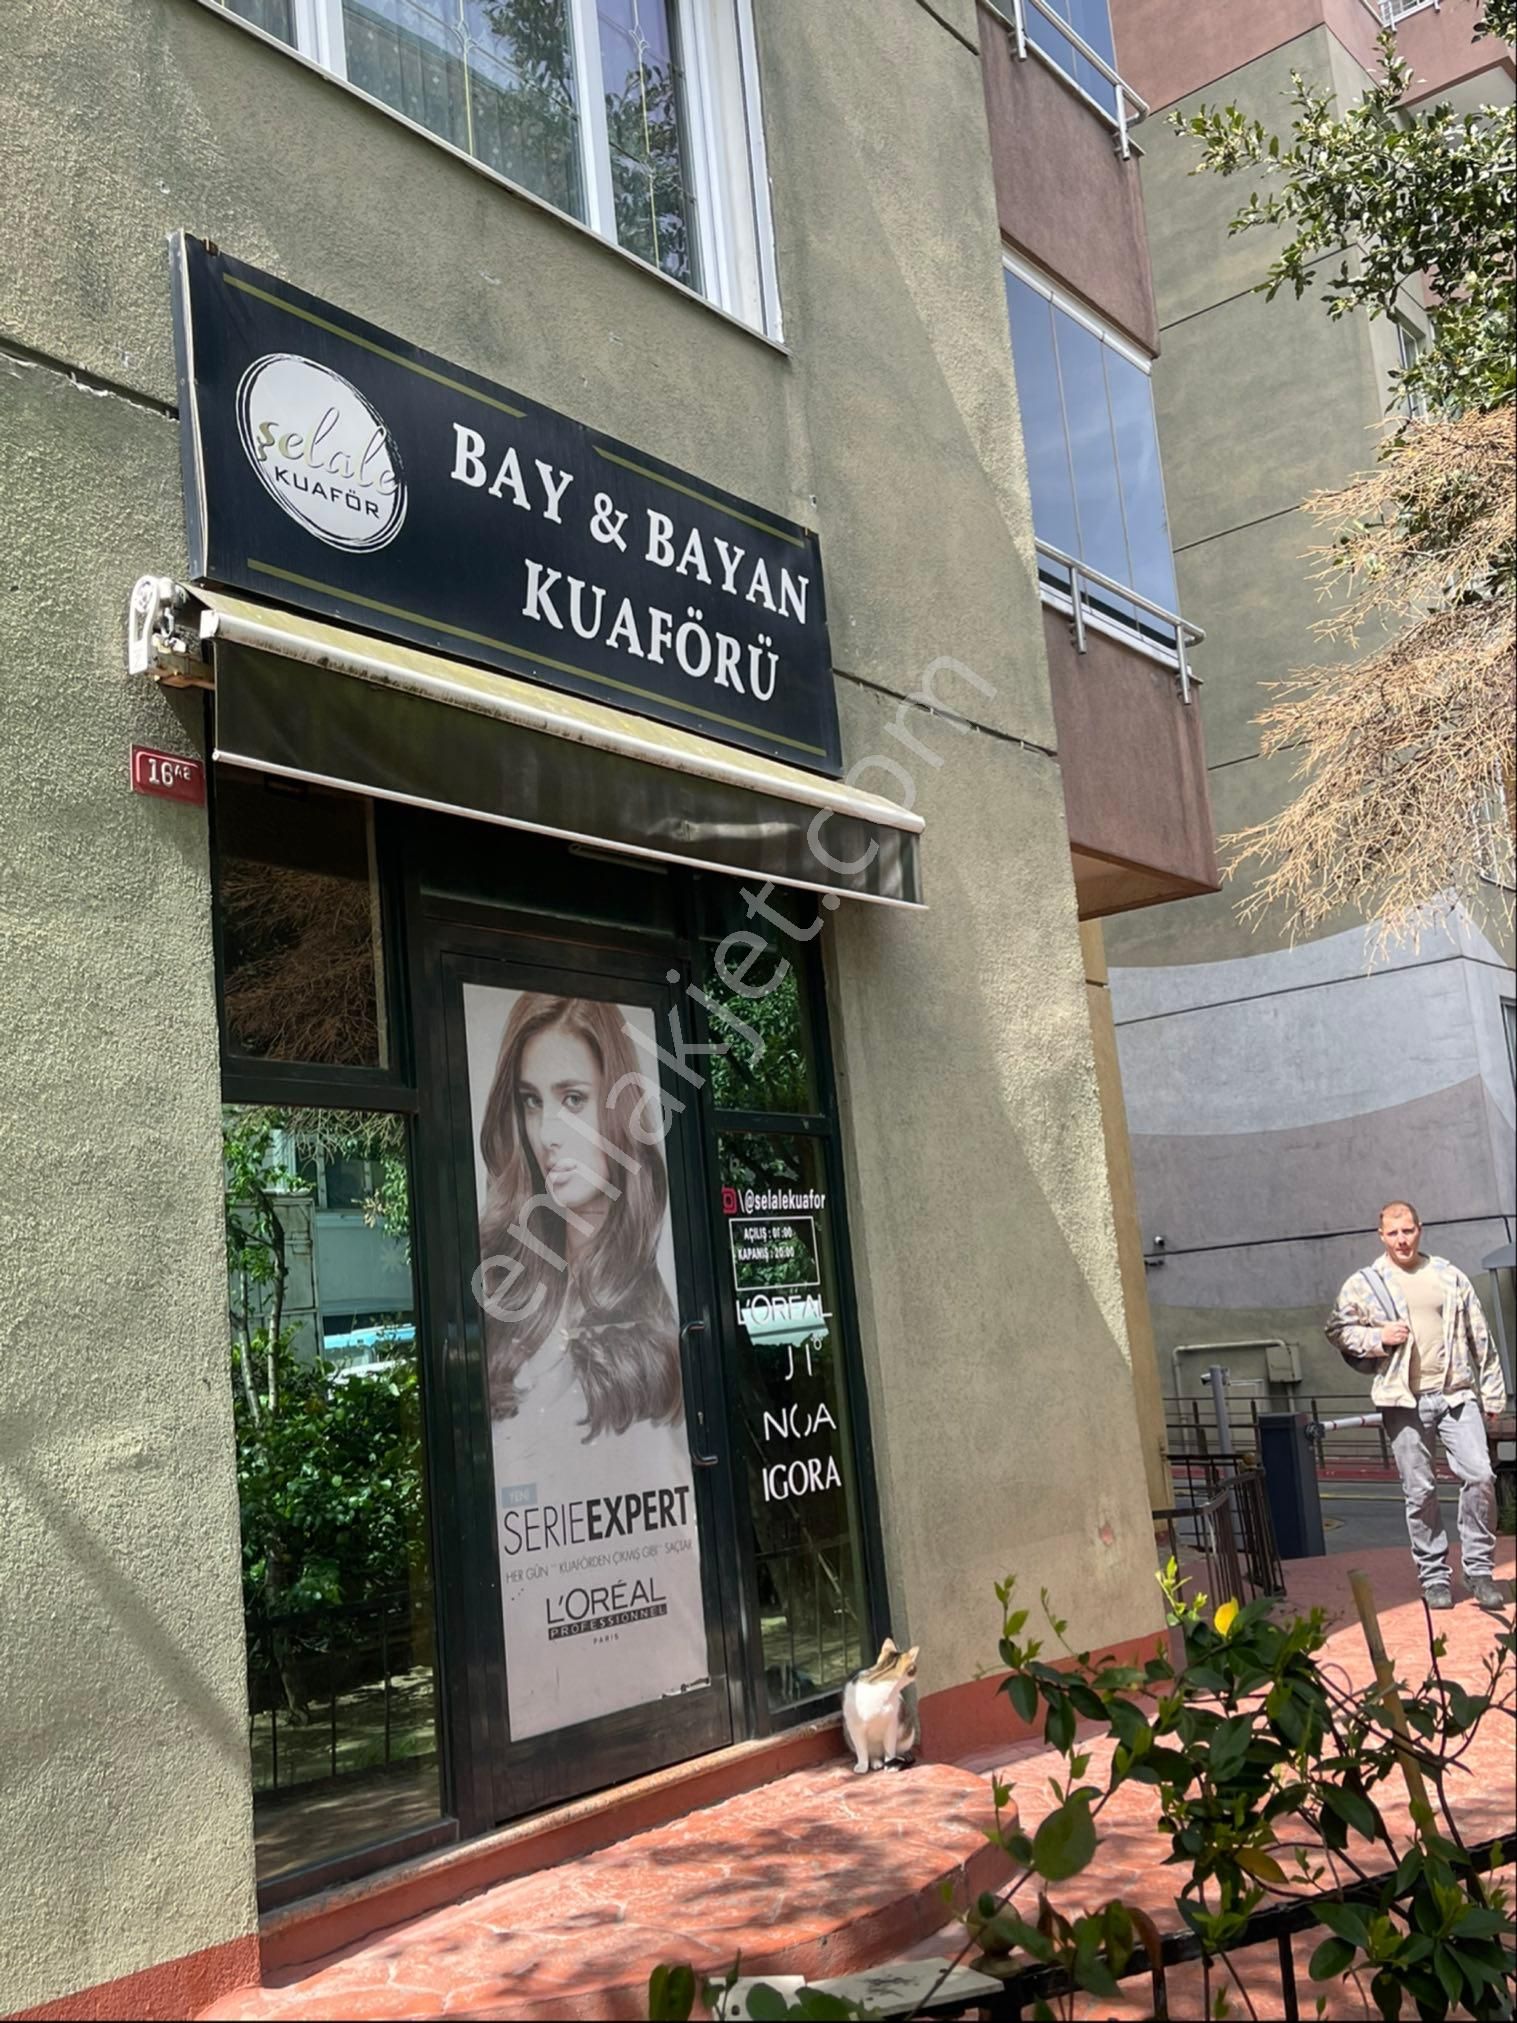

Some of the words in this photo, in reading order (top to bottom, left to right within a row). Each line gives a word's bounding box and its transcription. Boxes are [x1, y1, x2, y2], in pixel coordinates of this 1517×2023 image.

[274, 465, 380, 519] KUAFÖR
[451, 422, 574, 525] BAY
[589, 492, 629, 552] &
[645, 508, 810, 624] BAYAN
[521, 558, 780, 701] KUAFÖRÜ
[762, 1455, 842, 1502] IGORA
[546, 1577, 667, 1624] L'ORÉAL
[550, 1604, 667, 1639] PROFESSIONNEL
